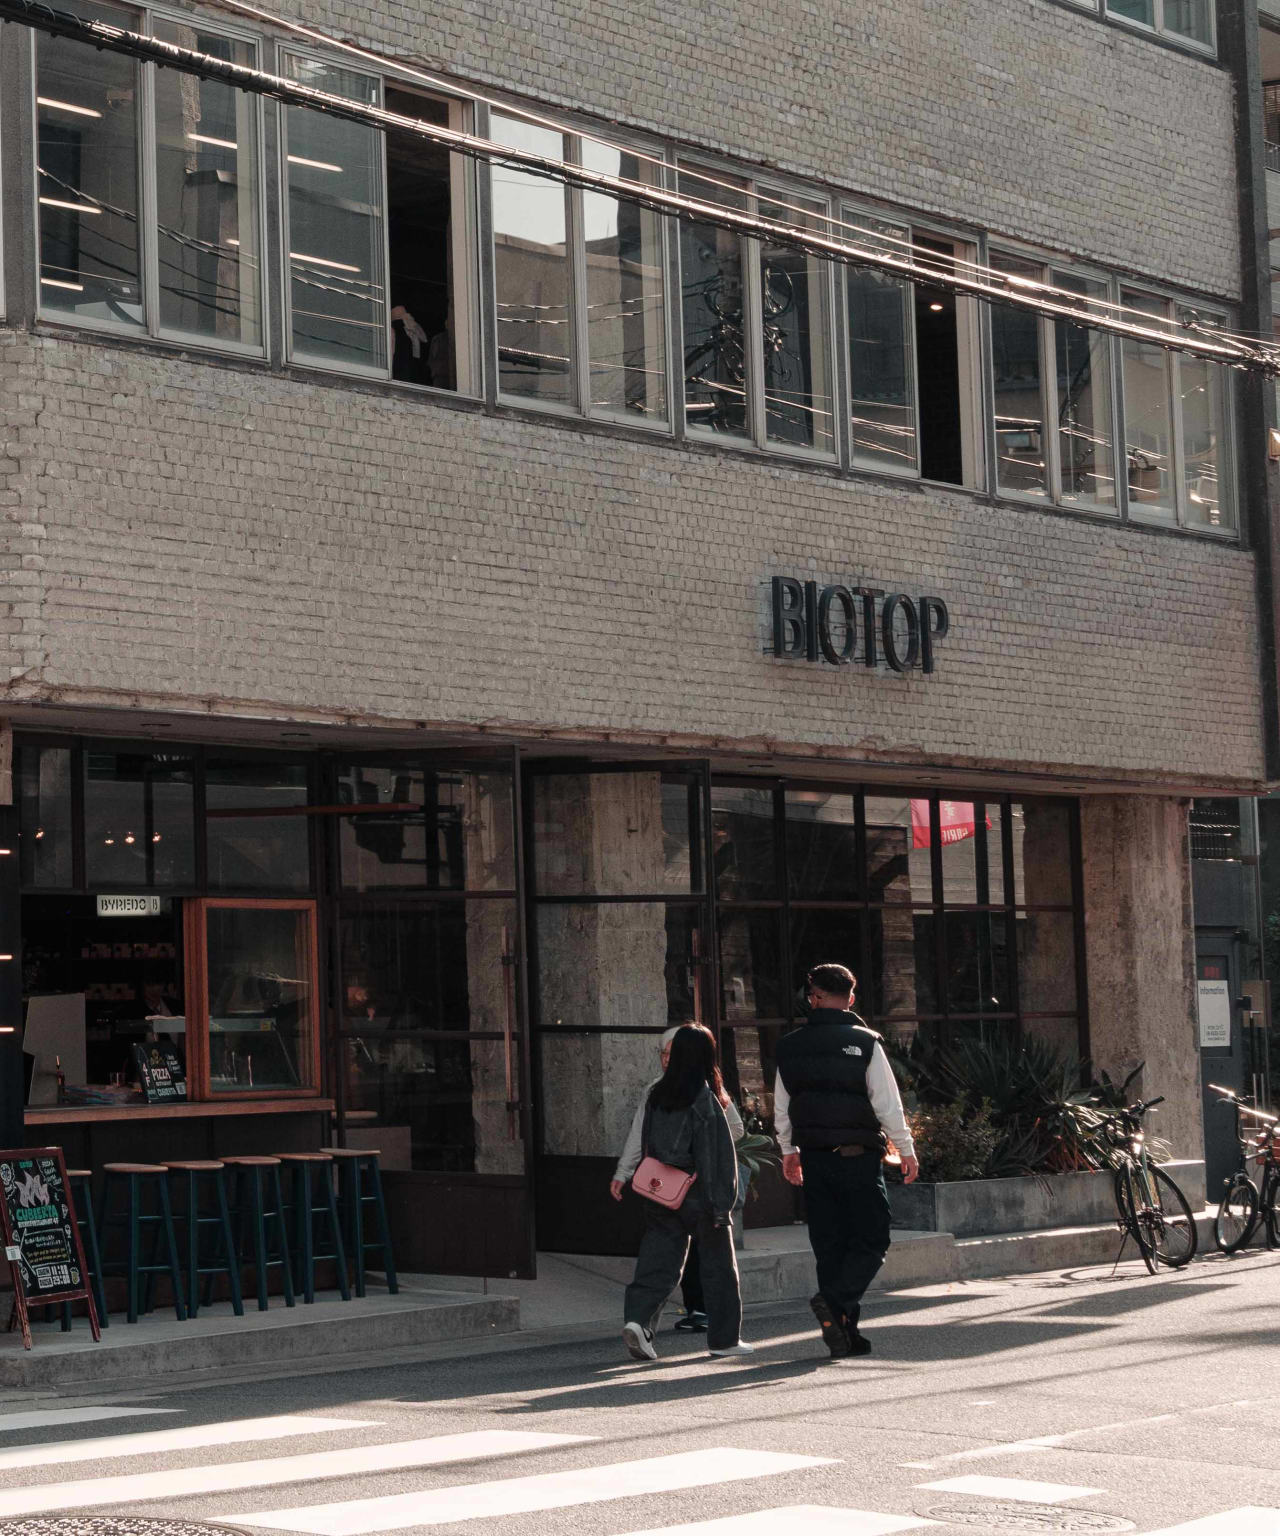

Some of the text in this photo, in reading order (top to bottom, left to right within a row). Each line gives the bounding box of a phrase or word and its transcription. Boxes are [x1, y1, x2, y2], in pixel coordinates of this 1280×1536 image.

[771, 575, 950, 674] BIOTOP
[101, 898, 146, 911] BYREDO
[150, 1067, 171, 1082] PIZZA
[16, 1205, 59, 1222] CUBIERTA
